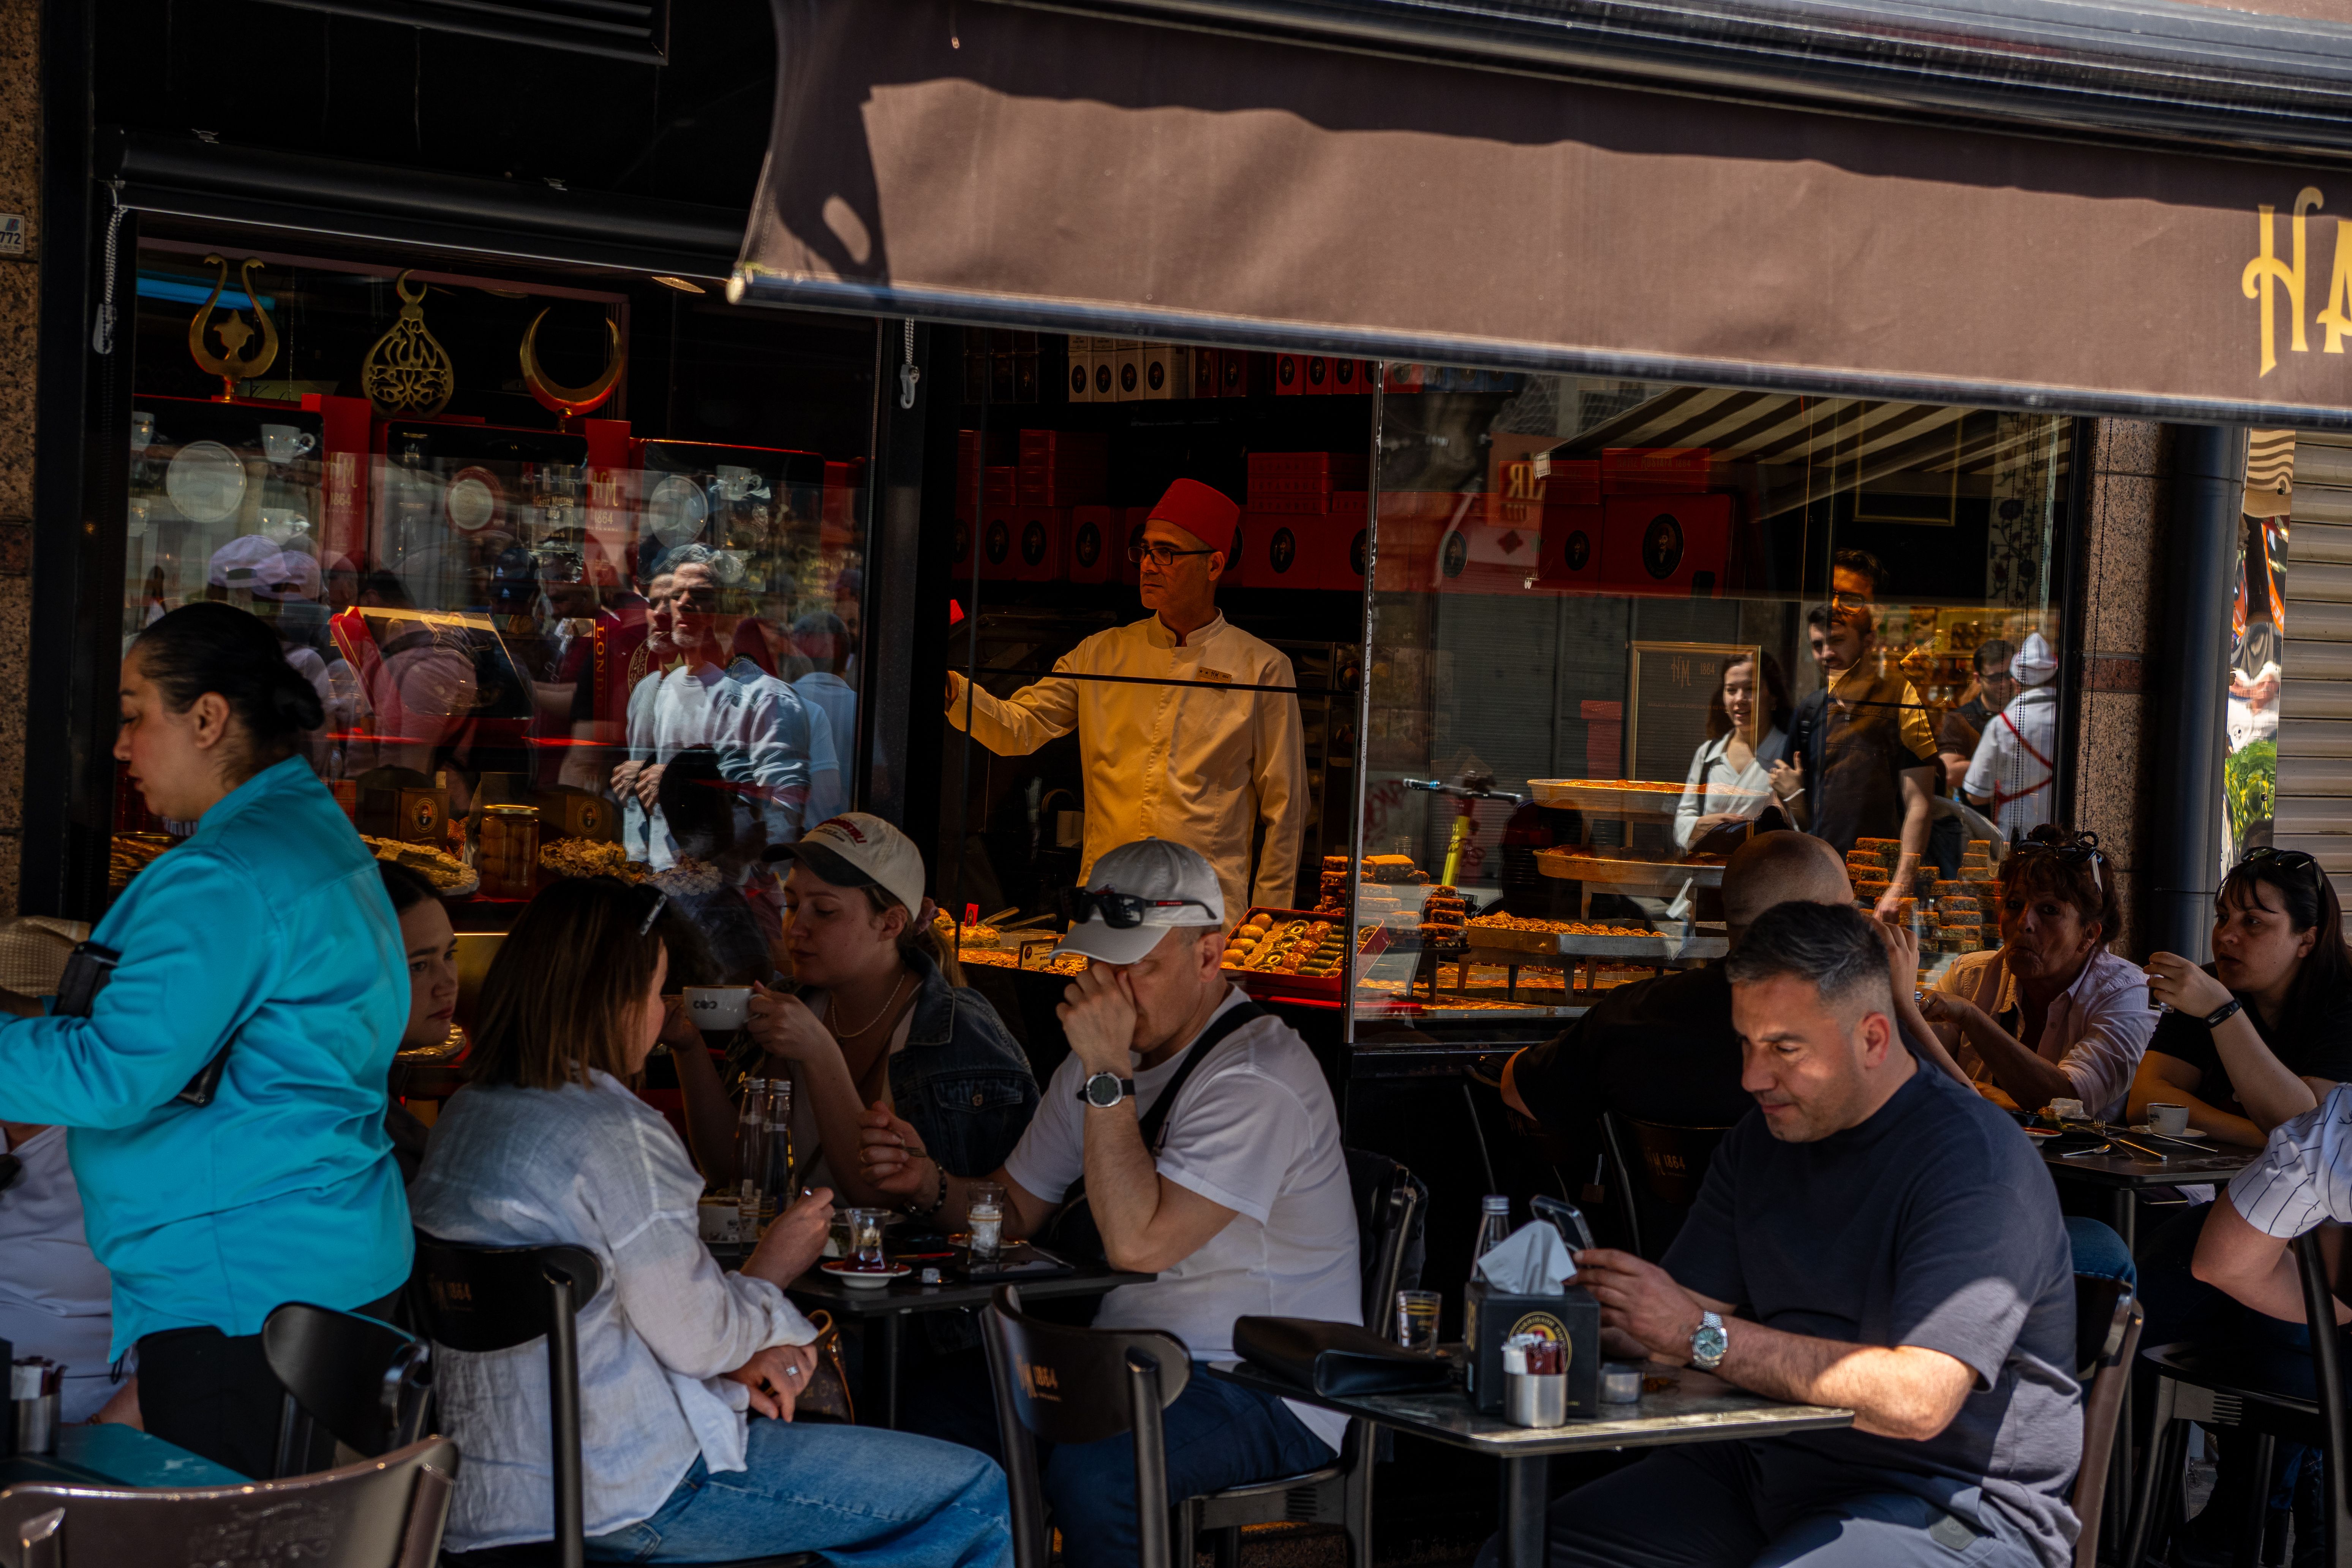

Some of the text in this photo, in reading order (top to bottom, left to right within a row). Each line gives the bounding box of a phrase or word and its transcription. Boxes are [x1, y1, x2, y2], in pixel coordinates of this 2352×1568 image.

[1675, 459, 1691, 468] 1864
[330, 493, 352, 506] 1864
[594, 511, 613, 525] 1864
[1671, 656, 1715, 689] HM 1864
[1663, 1154, 1686, 1170] 1864
